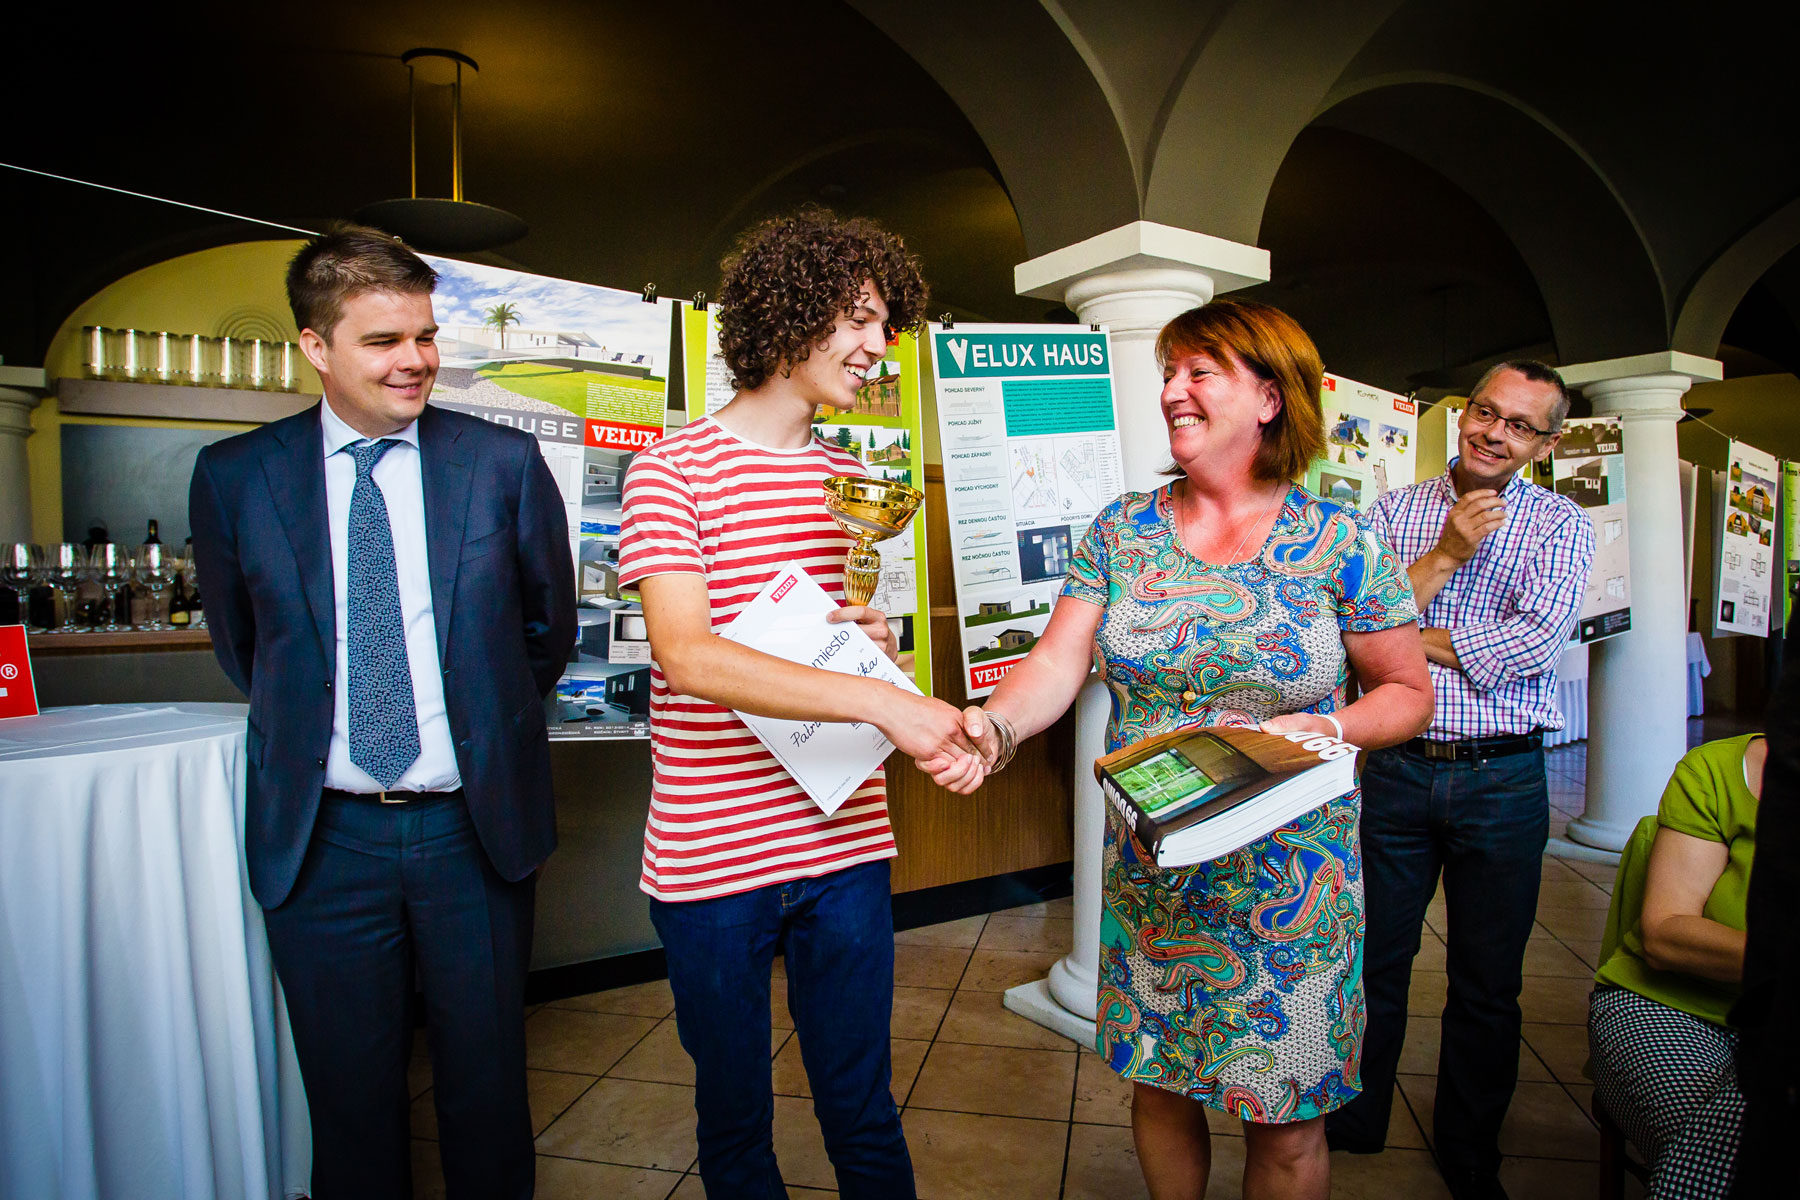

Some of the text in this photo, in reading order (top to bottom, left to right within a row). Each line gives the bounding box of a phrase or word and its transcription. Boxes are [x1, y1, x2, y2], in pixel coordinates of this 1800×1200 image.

[947, 338, 1104, 374] VELUX HAUS
[1395, 400, 1414, 412] VELUX
[773, 576, 797, 601] VELUX
[811, 628, 850, 670] miesto
[974, 664, 1016, 684] VELU
